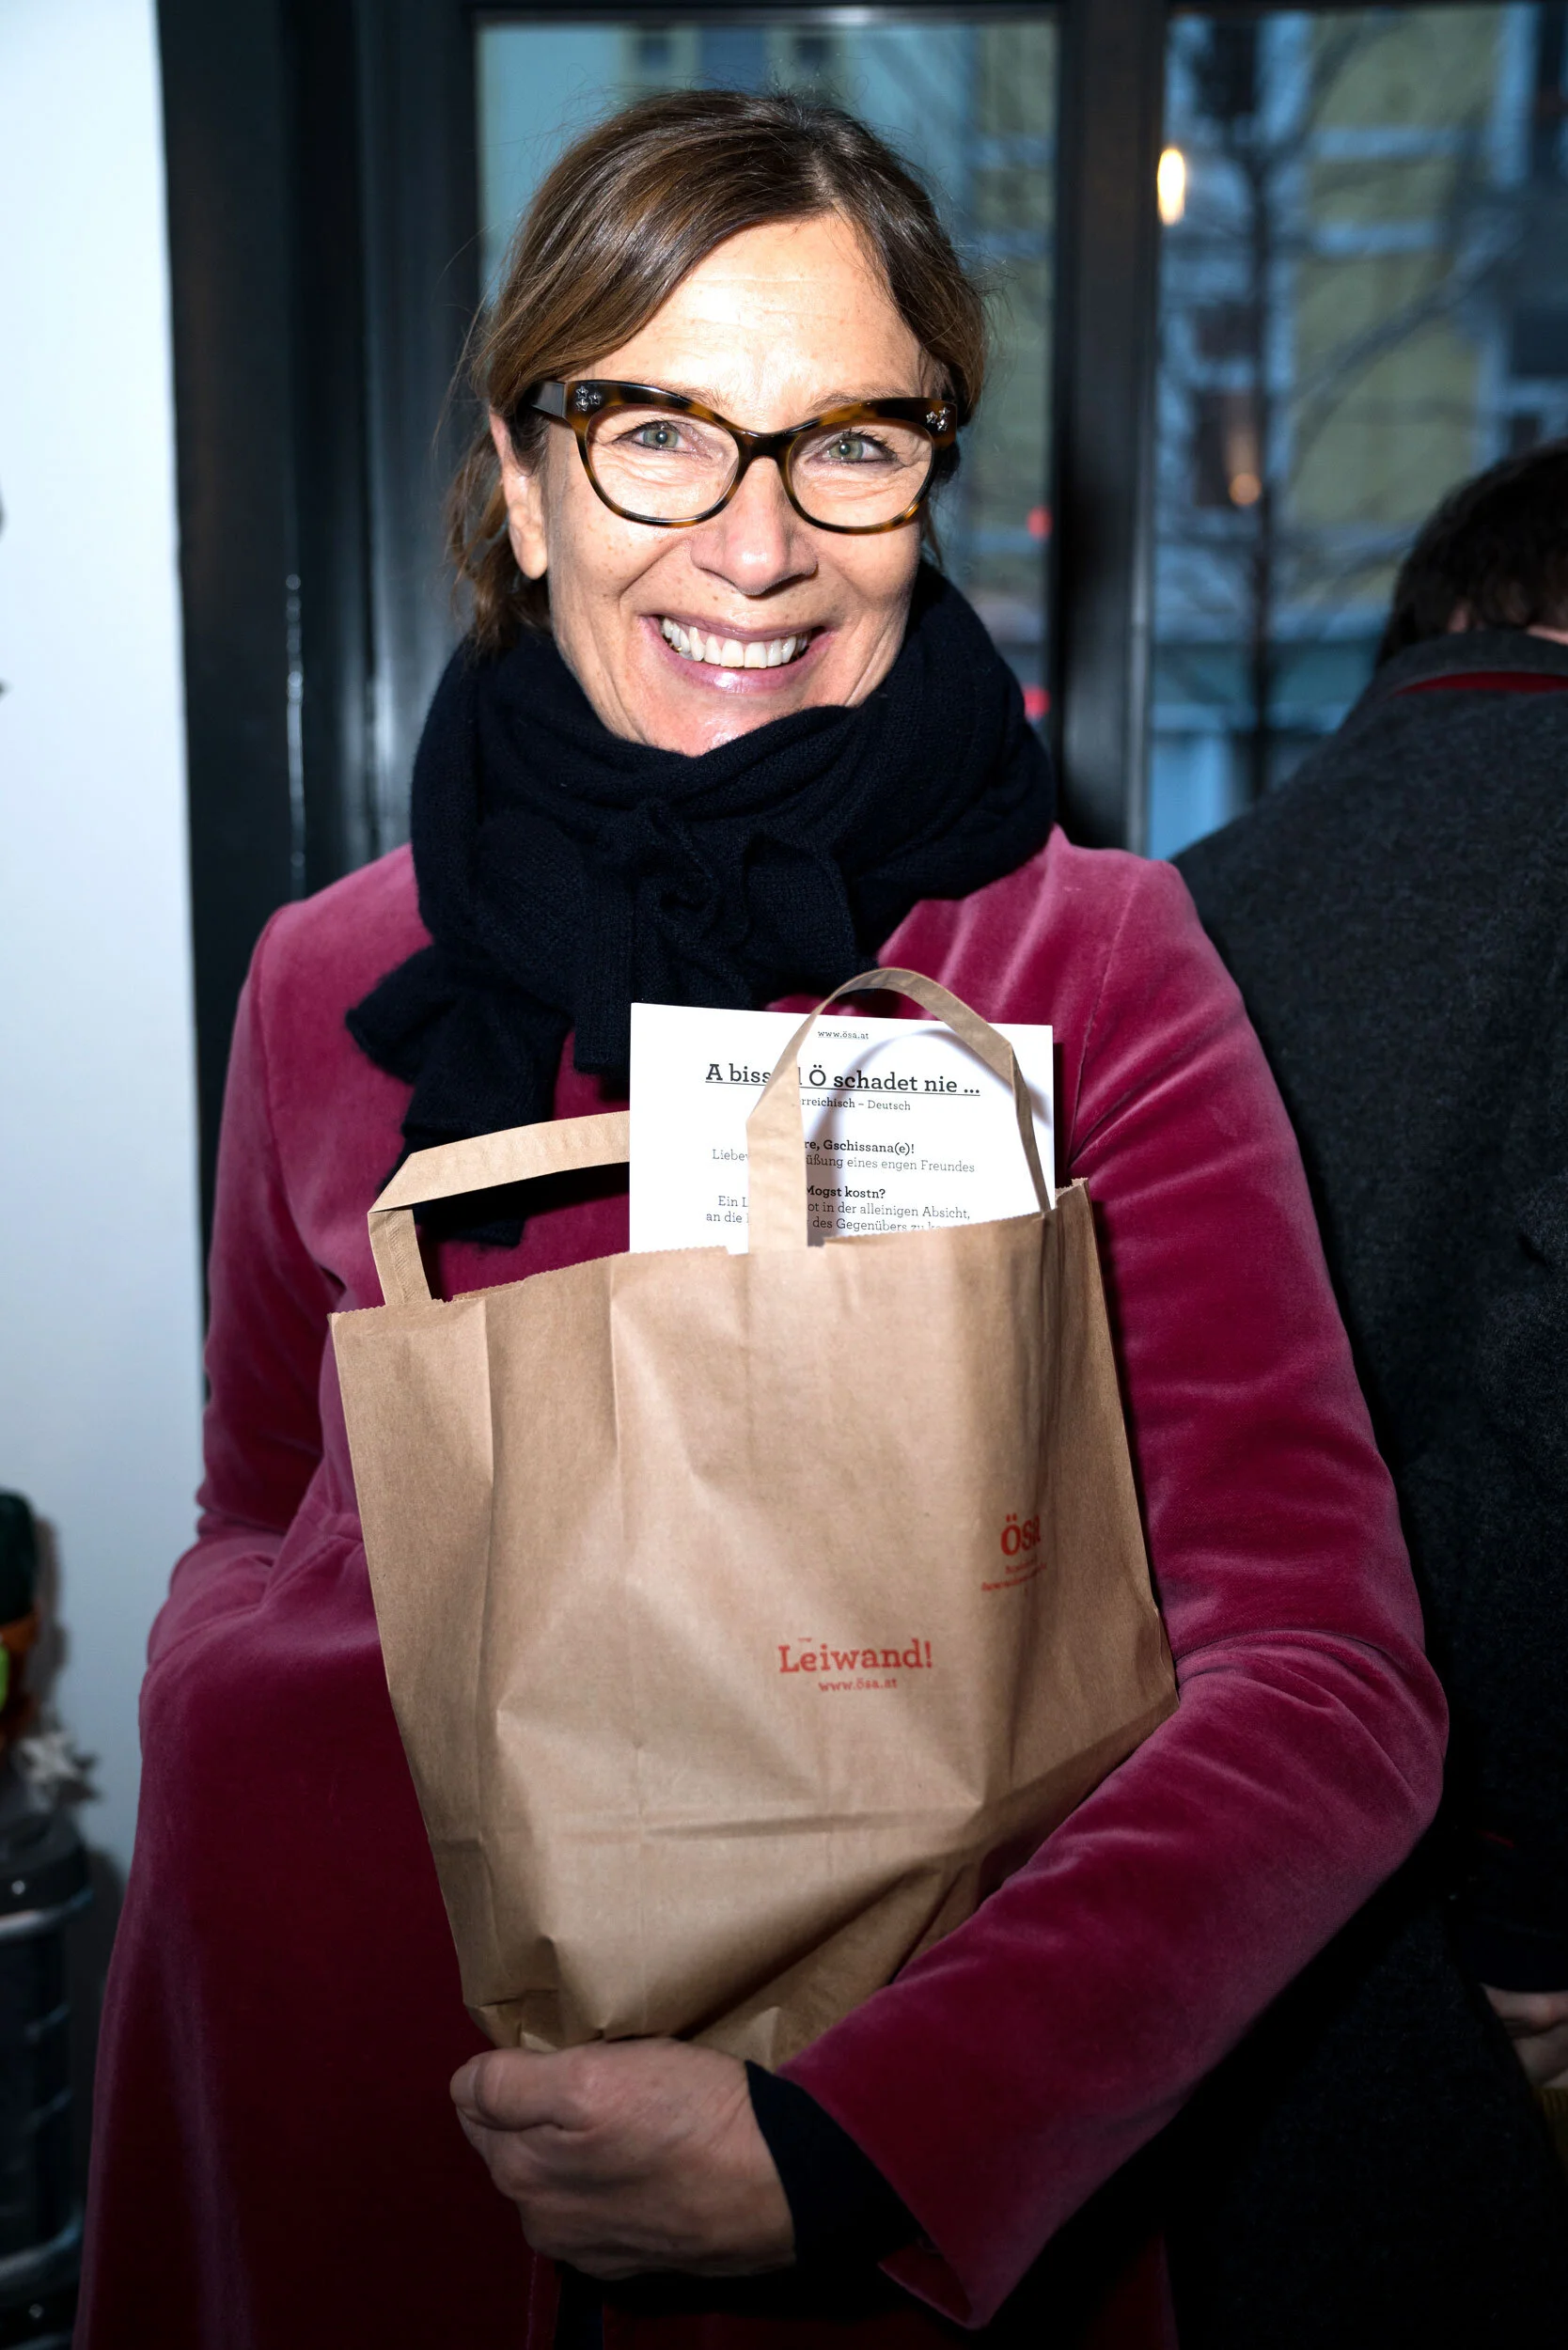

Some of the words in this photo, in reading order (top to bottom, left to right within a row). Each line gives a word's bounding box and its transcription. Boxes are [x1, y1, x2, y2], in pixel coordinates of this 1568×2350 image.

[818, 1030, 869, 1040] www.ösa.at
[706, 1063, 723, 1081] A
[808, 1064, 826, 1087] Ö
[833, 1070, 917, 1091] schadet
[924, 1075, 957, 1092] nie
[801, 1097, 855, 1108] rreichisch
[868, 1100, 911, 1110] Deutsch
[823, 1139, 915, 1156] Gschissana(e)!
[847, 1157, 878, 1168] eines
[881, 1160, 917, 1171] engen
[920, 1160, 975, 1172] Freundes
[806, 1185, 842, 1198] Mogst
[844, 1185, 886, 1198] kostn?
[718, 1195, 738, 1207] Ein
[823, 1202, 835, 1213] in
[838, 1201, 857, 1214] der
[860, 1203, 918, 1218] alleinigen
[922, 1206, 970, 1220] Absicht,
[724, 1211, 742, 1223] die
[812, 1216, 833, 1229] des
[836, 1218, 907, 1232] Gegenübers
[777, 1637, 933, 1673] Leiwand!
[818, 1677, 898, 1692] www.ösa.at
